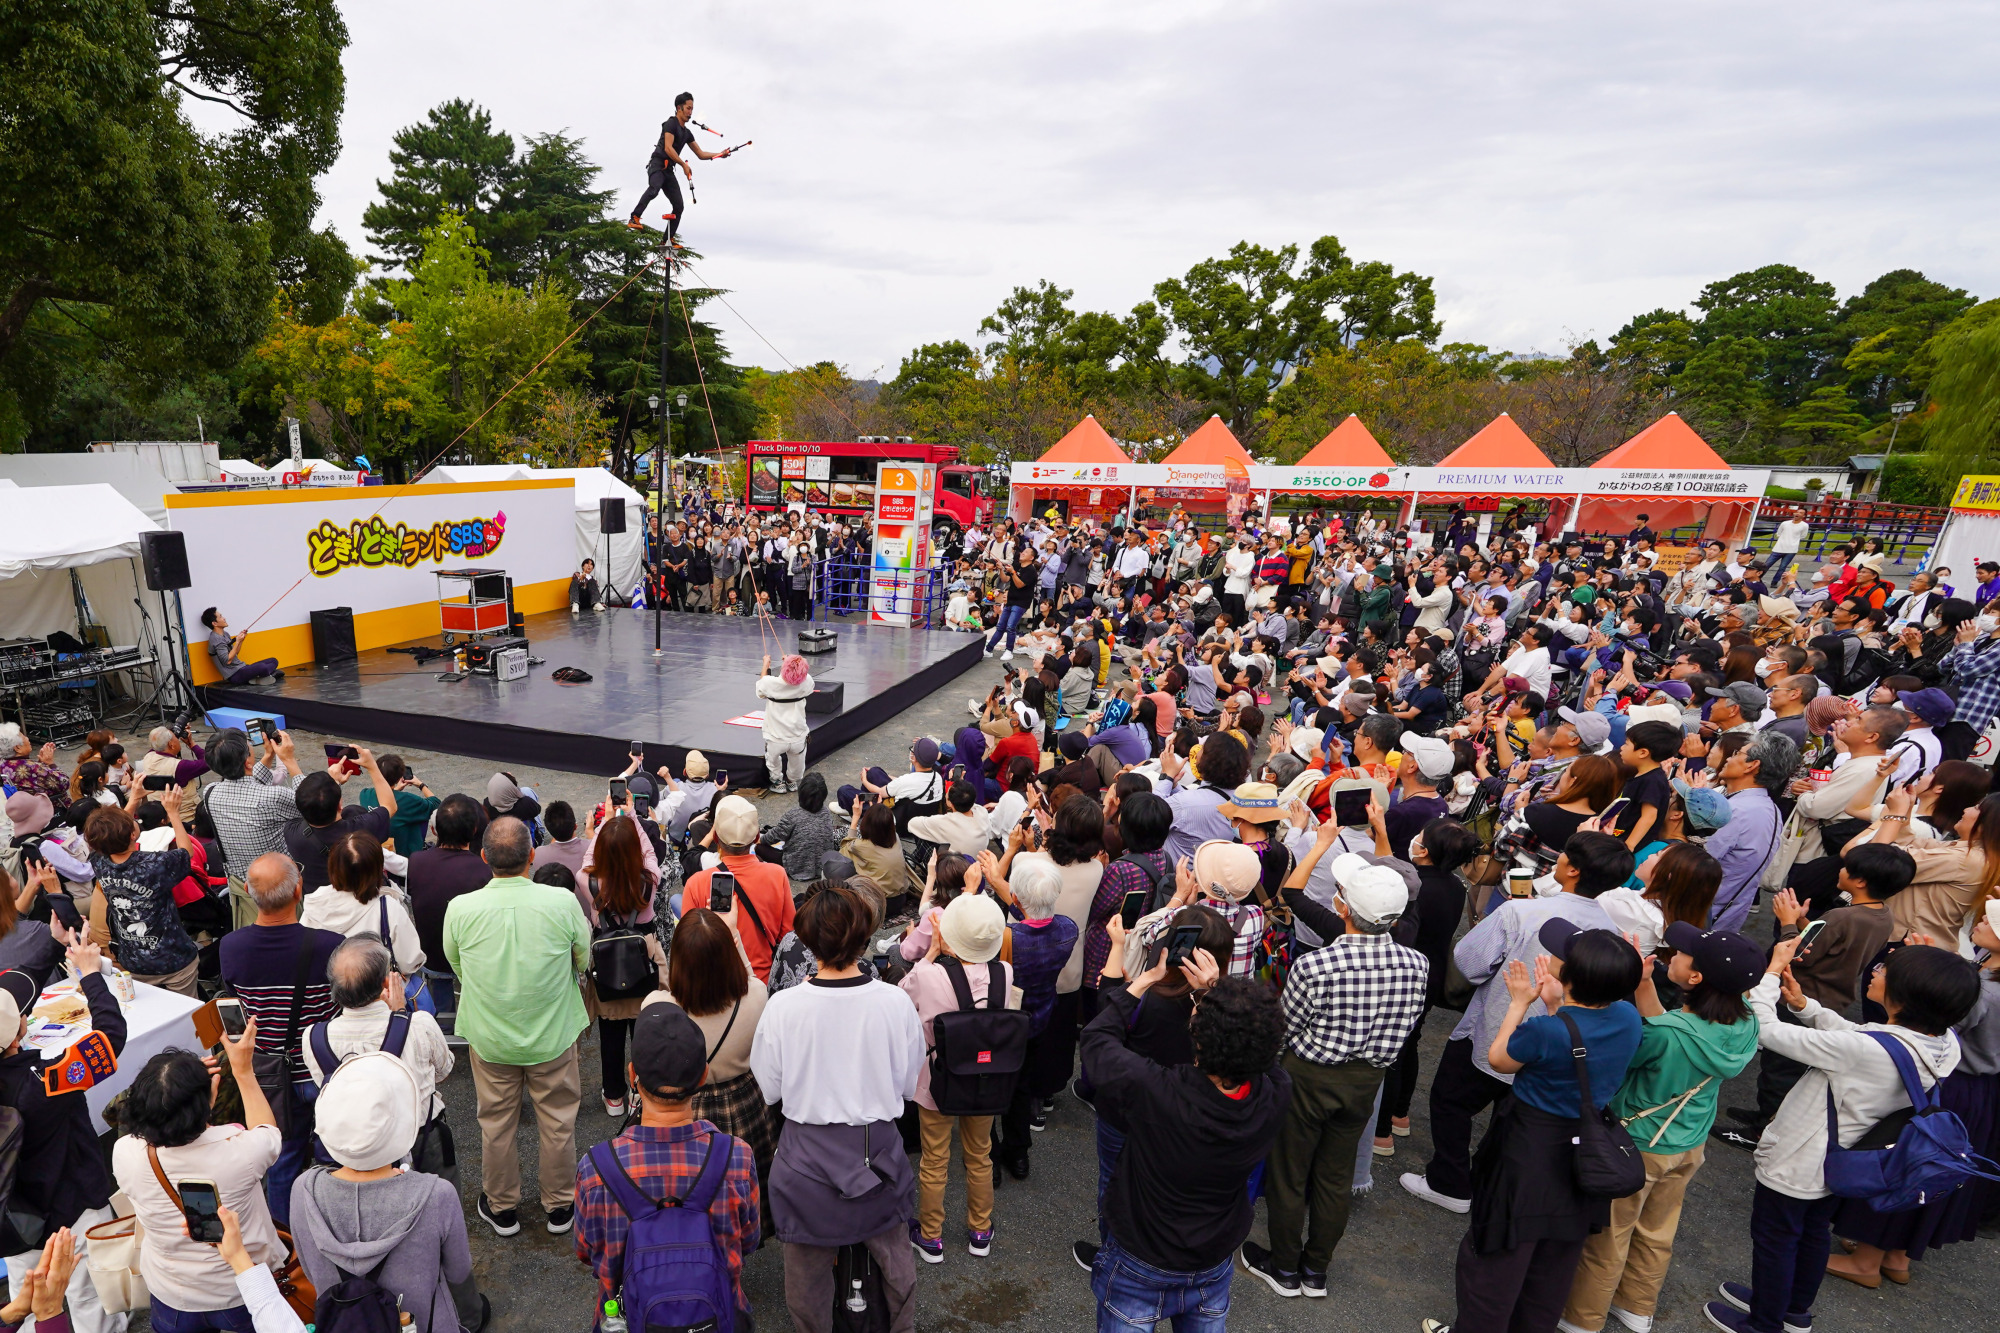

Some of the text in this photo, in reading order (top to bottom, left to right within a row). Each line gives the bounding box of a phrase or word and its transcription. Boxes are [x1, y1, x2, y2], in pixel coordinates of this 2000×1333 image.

[799, 445, 821, 453] 10/10
[896, 473, 904, 486] 3
[1169, 471, 1225, 480] Orangetheo
[1437, 474, 1564, 485] PREMIUM WATER
[1668, 472, 1730, 480] 神奈川県観光協会
[1598, 481, 1749, 493] かながわの名産100選協議会
[451, 522, 484, 551] SBS
[466, 544, 483, 556] 2024
[98, 875, 121, 889] etty
